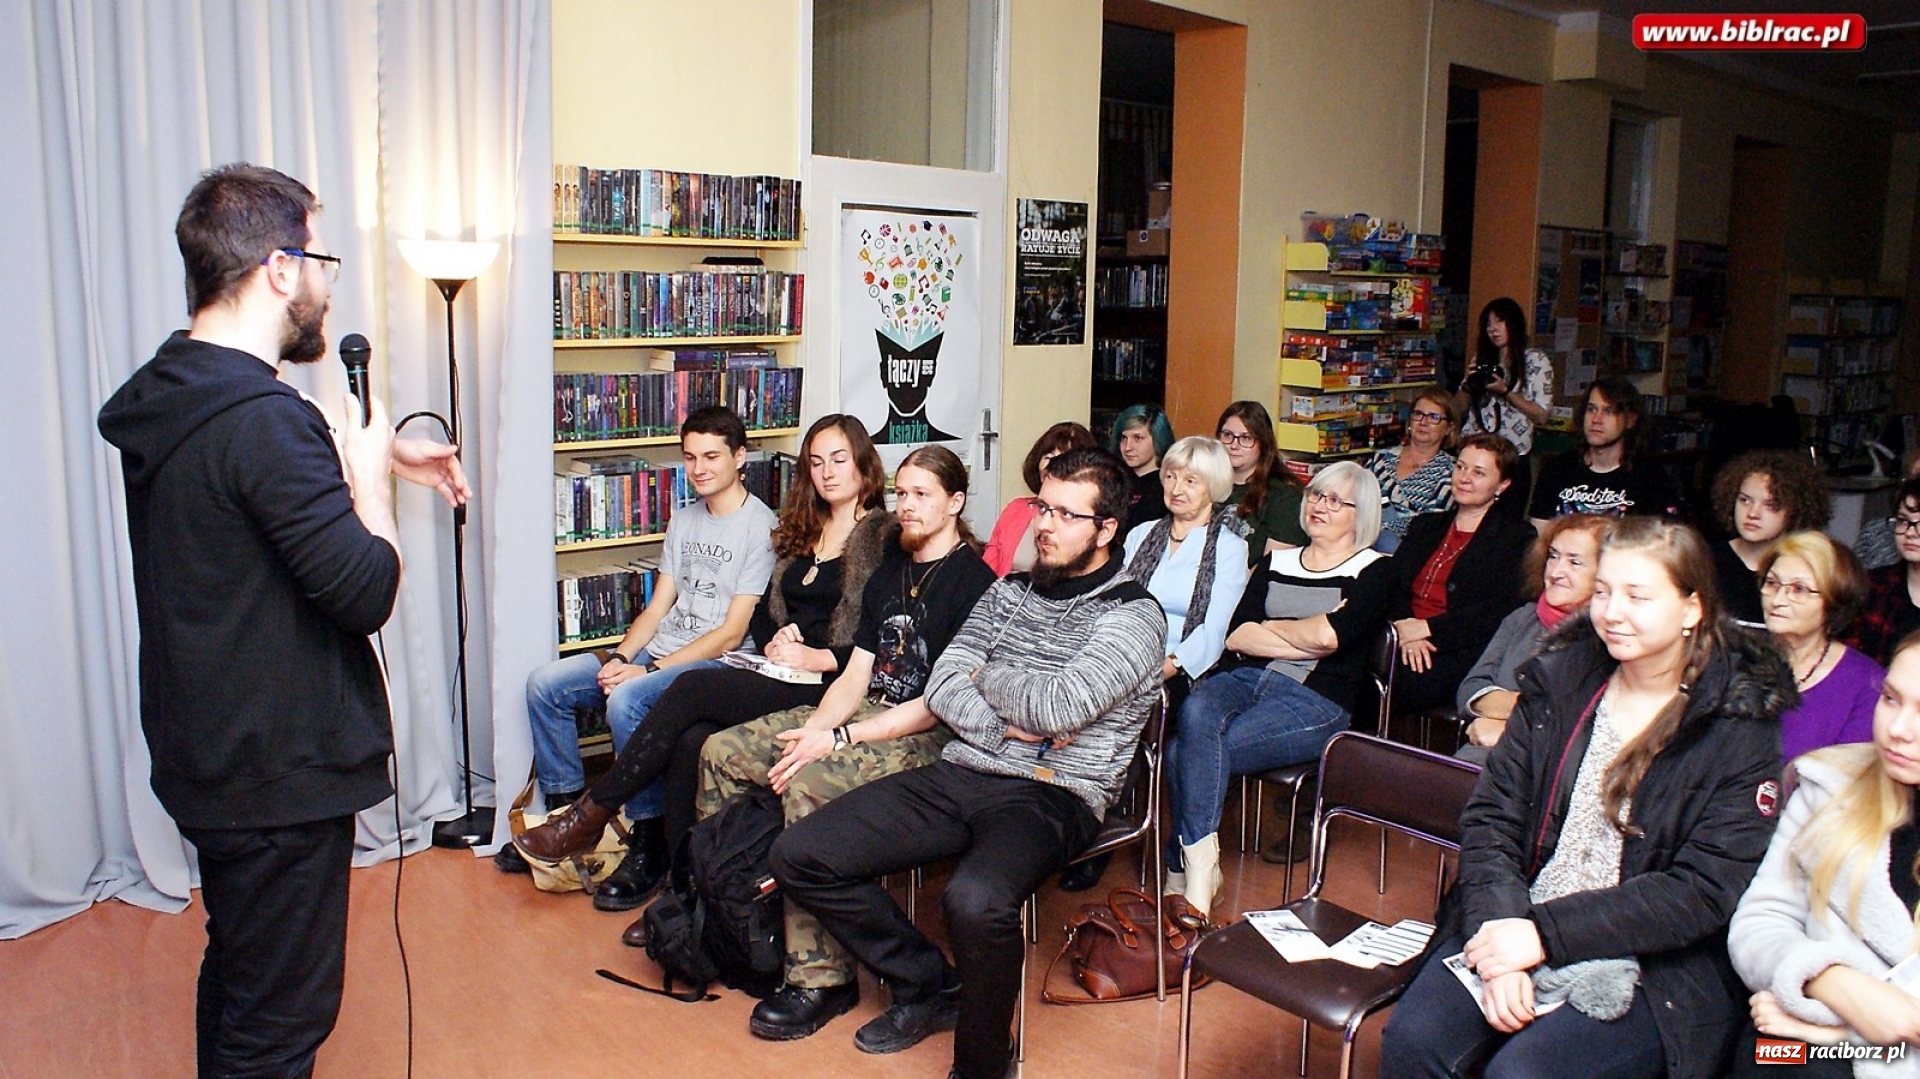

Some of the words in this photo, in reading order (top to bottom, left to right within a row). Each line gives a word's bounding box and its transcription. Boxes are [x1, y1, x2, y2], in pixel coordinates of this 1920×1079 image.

[1020, 227, 1081, 243] ODWAGA
[1020, 244, 1056, 254] RATUJE
[889, 420, 928, 447] książka
[1558, 484, 1634, 509] Woodstock
